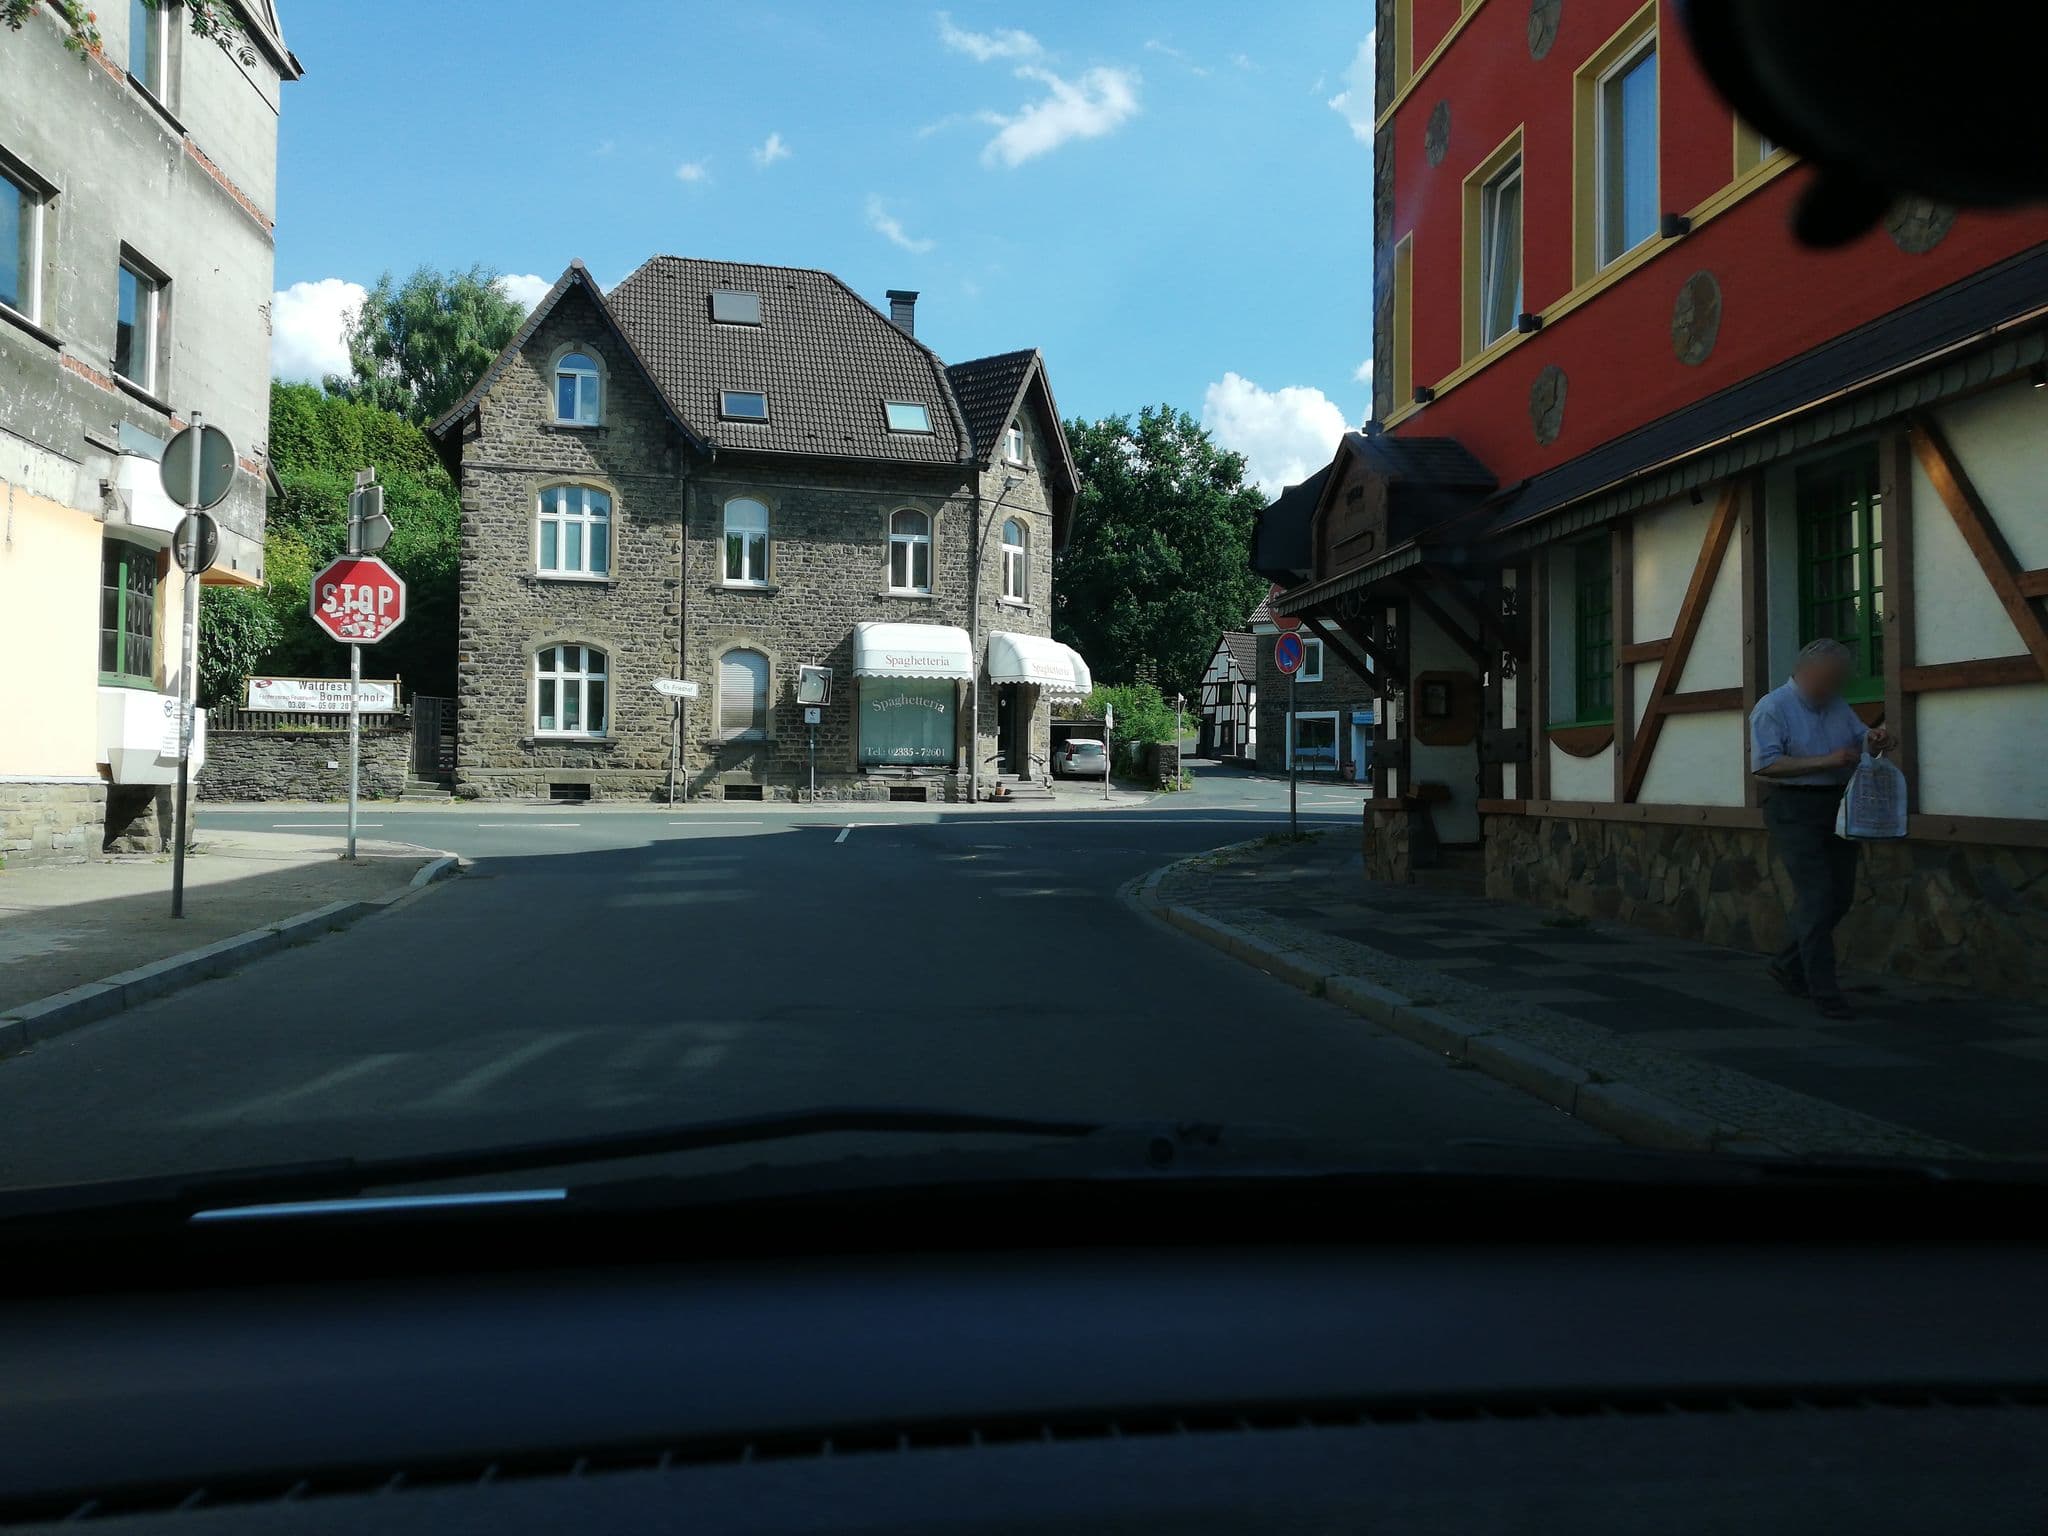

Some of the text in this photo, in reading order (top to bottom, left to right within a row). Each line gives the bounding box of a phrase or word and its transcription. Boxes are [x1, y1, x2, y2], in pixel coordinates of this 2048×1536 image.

[322, 583, 394, 615] STOP
[885, 654, 950, 667] Spaghetteria
[299, 681, 348, 692] Waldfest
[320, 692, 385, 702] Bommrholz
[872, 693, 946, 713] Spaghetteria
